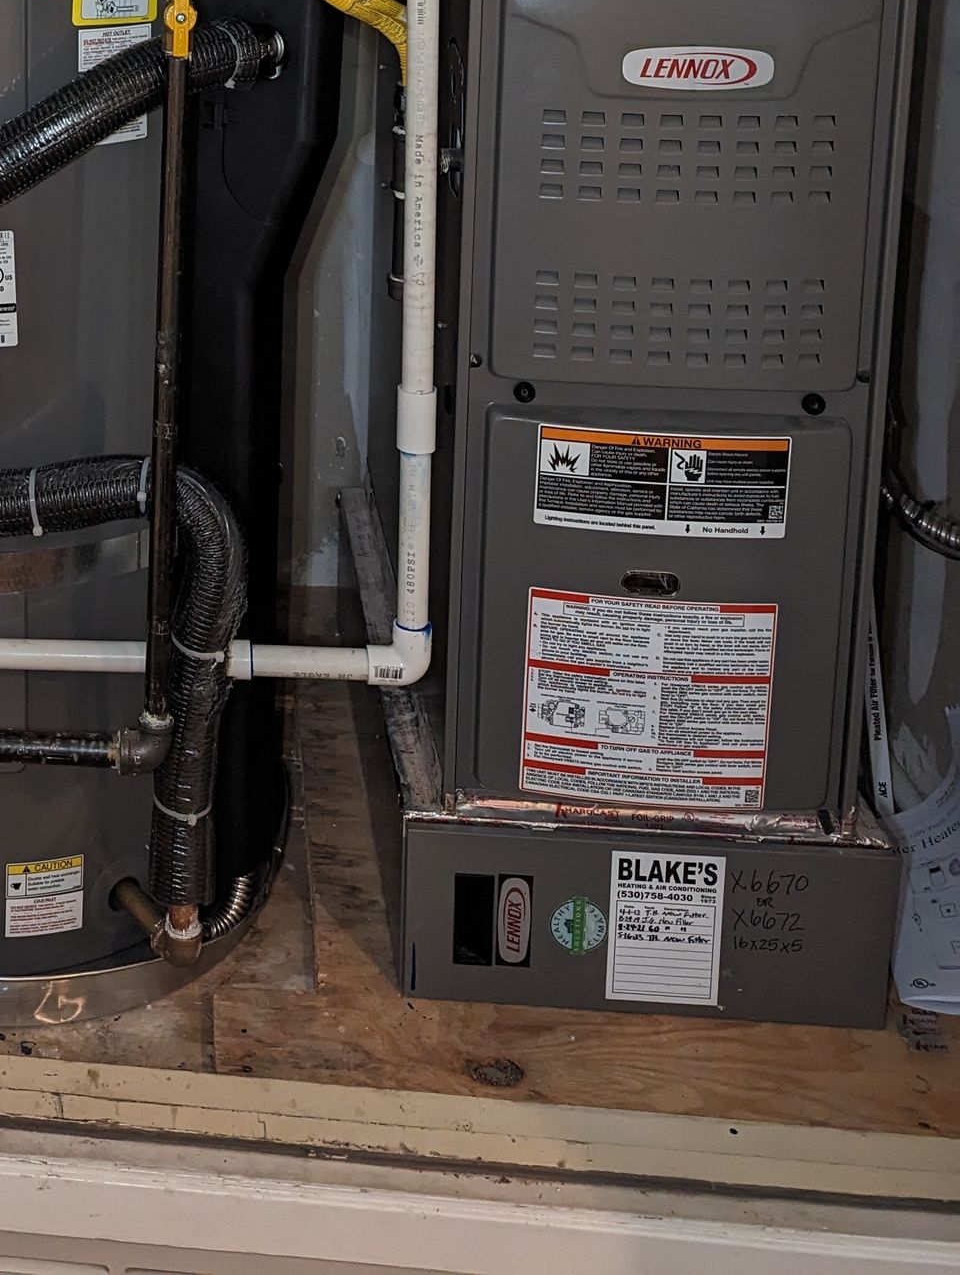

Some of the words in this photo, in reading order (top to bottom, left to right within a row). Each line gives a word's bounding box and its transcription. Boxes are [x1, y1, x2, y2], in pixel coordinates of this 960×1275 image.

[640, 58, 735, 79] LENNOX
[415, 134, 424, 165] Made
[414, 196, 423, 248] America
[643, 437, 702, 449] WARNING
[564, 517, 590, 525] instructions
[406, 550, 417, 595] 480PSI
[870, 678, 878, 695] Filter
[874, 713, 882, 741] Pleated
[631, 813, 674, 823] FOIL-GRIP
[35, 860, 72, 872] CAUTION
[618, 858, 717, 886] BLAKE'S
[731, 869, 809, 894] X6670
[617, 890, 693, 902] (530)758-4030
[756, 897, 774, 908] OR
[506, 899, 522, 953] LENNOX
[553, 904, 570, 946] HEALTHY
[587, 908, 605, 946] CLIMATE
[732, 909, 805, 931] X6672
